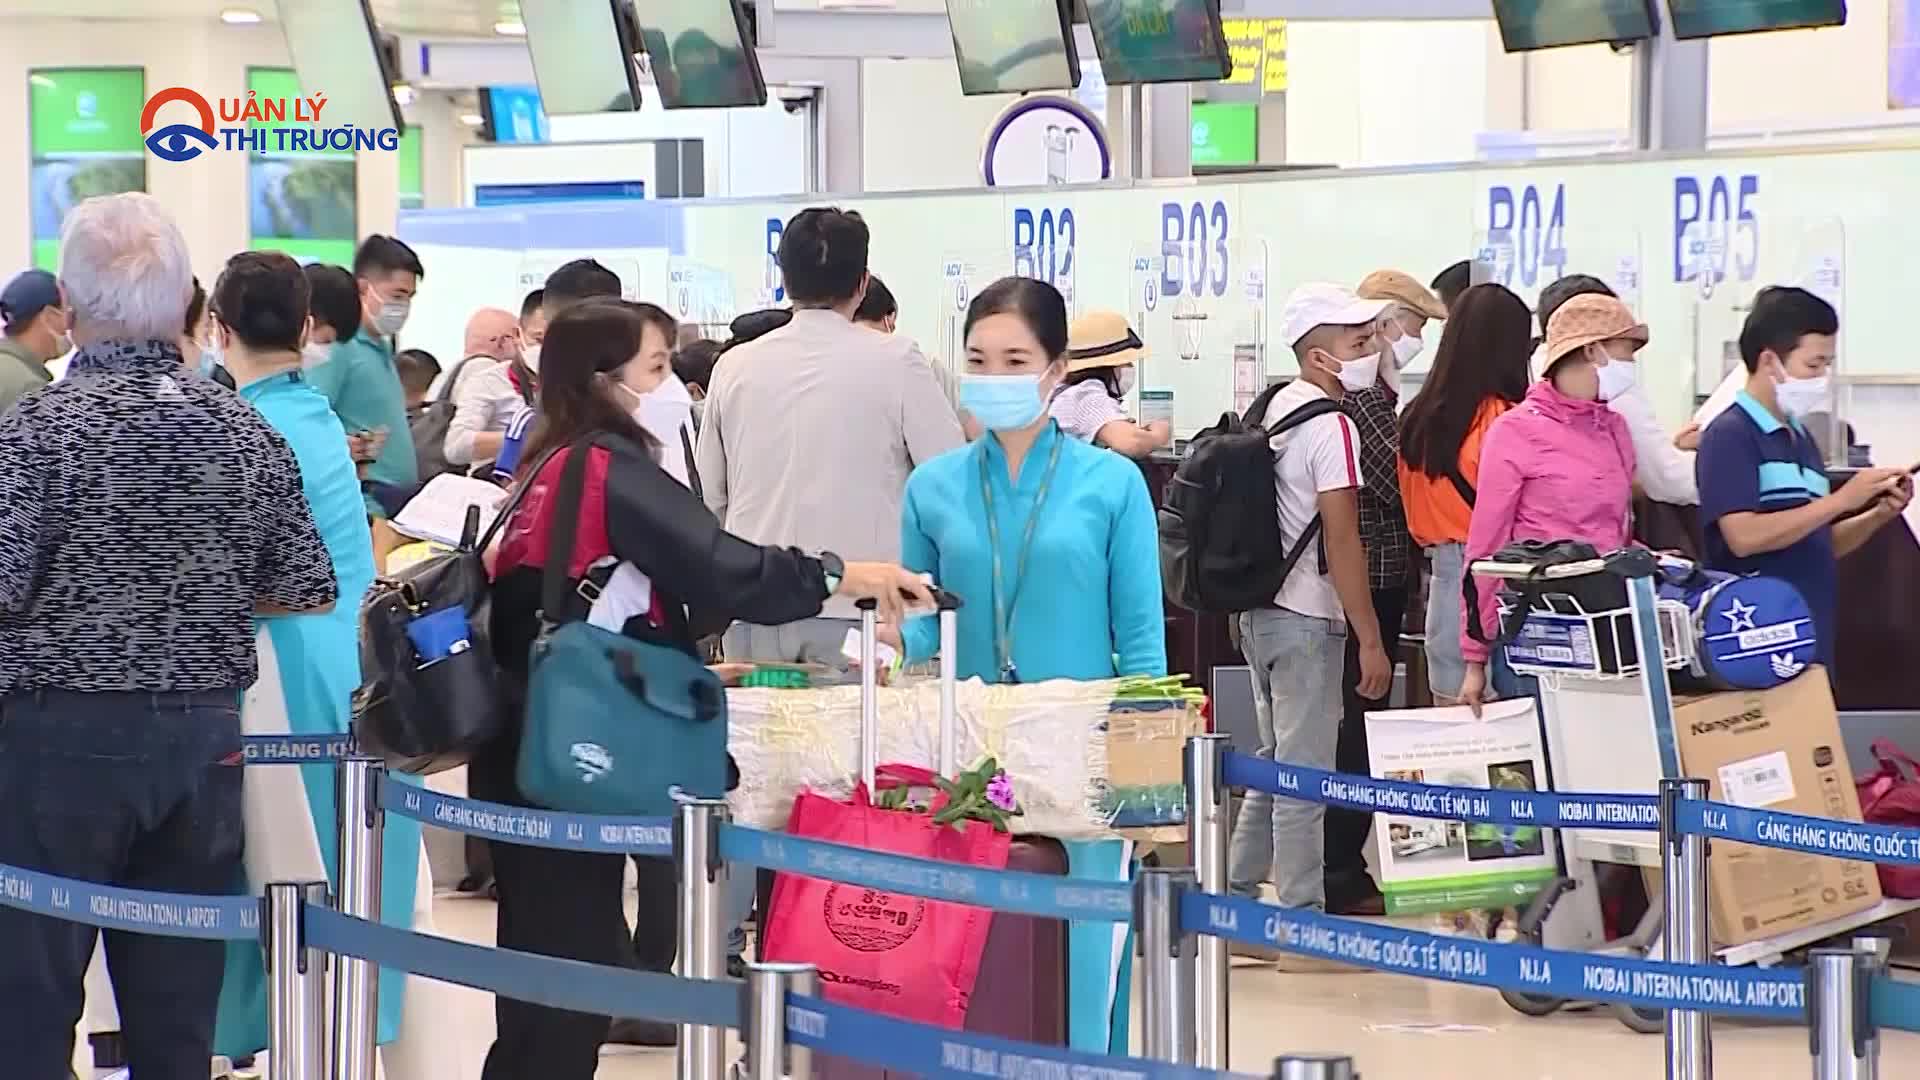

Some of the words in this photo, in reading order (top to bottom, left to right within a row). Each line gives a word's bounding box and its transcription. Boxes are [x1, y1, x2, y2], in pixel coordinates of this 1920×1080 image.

[1014, 207, 1075, 286] B02
[1161, 200, 1228, 297] B03
[1488, 183, 1567, 287] B04
[1675, 175, 1757, 282] B05
[946, 264, 961, 277] ACV
[1135, 258, 1150, 272] ACV
[1375, 786, 1410, 809] KHÔNG
[1411, 789, 1437, 812] QUỐC
[1439, 791, 1452, 812] TẾ
[1453, 794, 1470, 818] NỘI
[1511, 799, 1534, 819] N.I.A
[1559, 802, 1592, 821] NOIBAI
[1703, 809, 1728, 831] N.I.A
[1829, 829, 1871, 854] KHÔNG
[1874, 831, 1907, 858] QUỐC
[51, 887, 70, 911] N.I.A
[117, 899, 183, 926] INTERNATIONAL
[185, 908, 220, 929] AIRPORT
[1338, 931, 1381, 962] KHÔNG
[1382, 935, 1419, 968] QUỐC
[1421, 939, 1438, 971] TẾ
[1519, 956, 1552, 985] N.I.A
[1584, 964, 1630, 992] NOIBAI
[1633, 970, 1741, 1004] INTERNATIONAL
[1745, 980, 1806, 1008] AIRPORT
